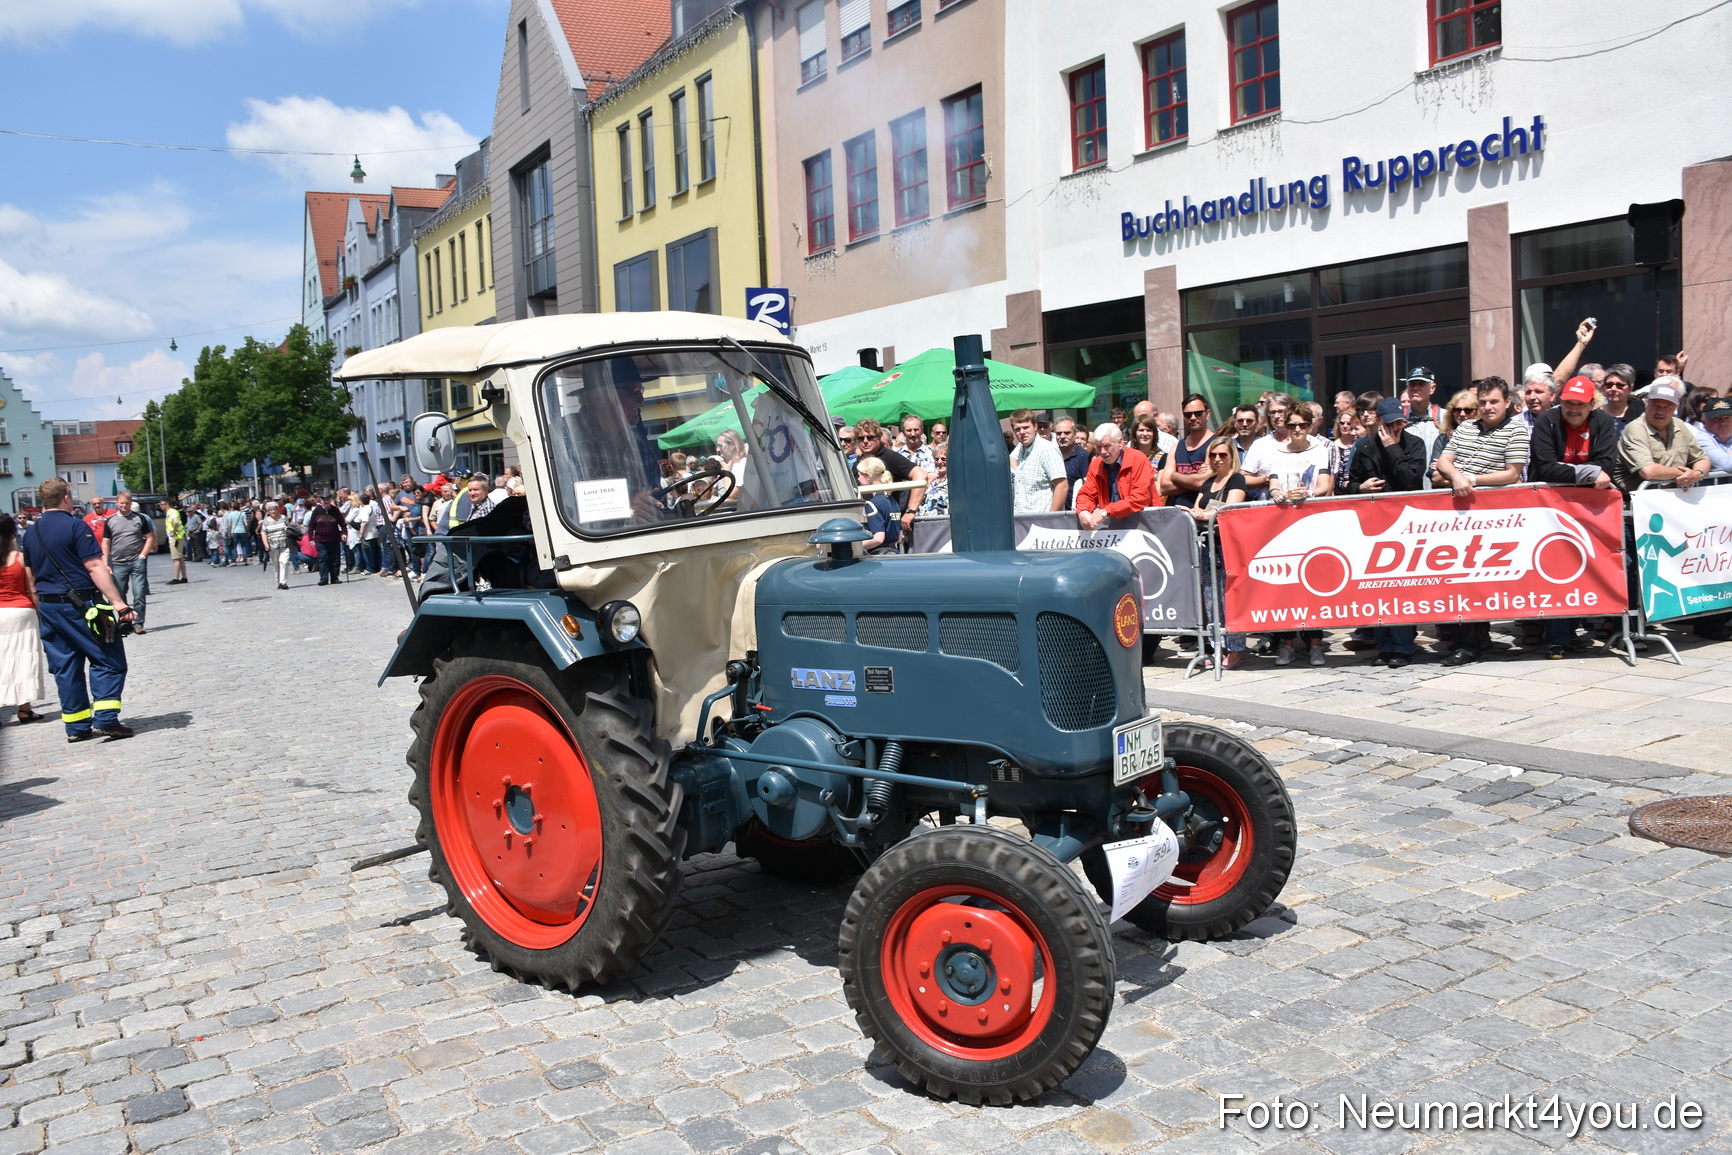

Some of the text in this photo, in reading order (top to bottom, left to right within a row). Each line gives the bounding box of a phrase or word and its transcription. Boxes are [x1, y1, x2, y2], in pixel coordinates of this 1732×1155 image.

[1121, 114, 1547, 241] Buchhandlung Rupprecht
[1400, 513, 1527, 535] Autoklassik
[1030, 534, 1122, 550] Autoklassik
[1364, 535, 1519, 575] Dietz
[1357, 577, 1443, 590] BREITENBRUNN
[1251, 588, 1598, 623] www.autoklassik-dietz.de
[1121, 614, 1136, 628] LANZ
[793, 669, 853, 691] LANZ
[1126, 729, 1141, 753] NM
[1121, 743, 1160, 776] BR 765
[1153, 837, 1172, 863] 592
